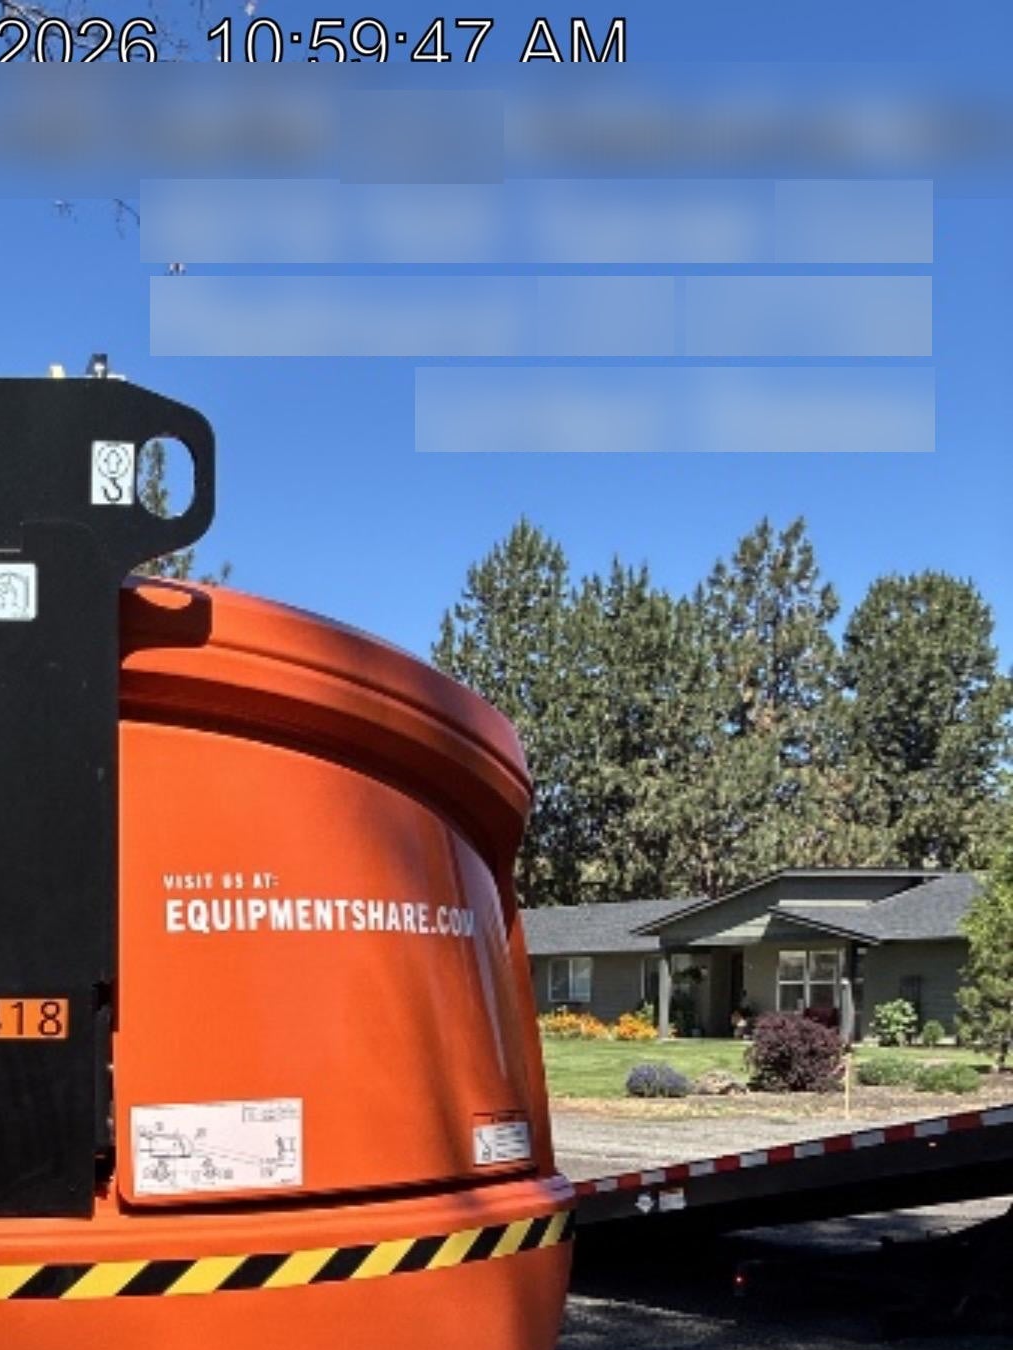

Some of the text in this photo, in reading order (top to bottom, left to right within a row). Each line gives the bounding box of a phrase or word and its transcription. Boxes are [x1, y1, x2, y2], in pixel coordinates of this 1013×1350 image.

[163, 872, 214, 890] VISIT
[222, 872, 244, 889] US
[165, 898, 475, 936] EQUIPMENTSHARE.COM
